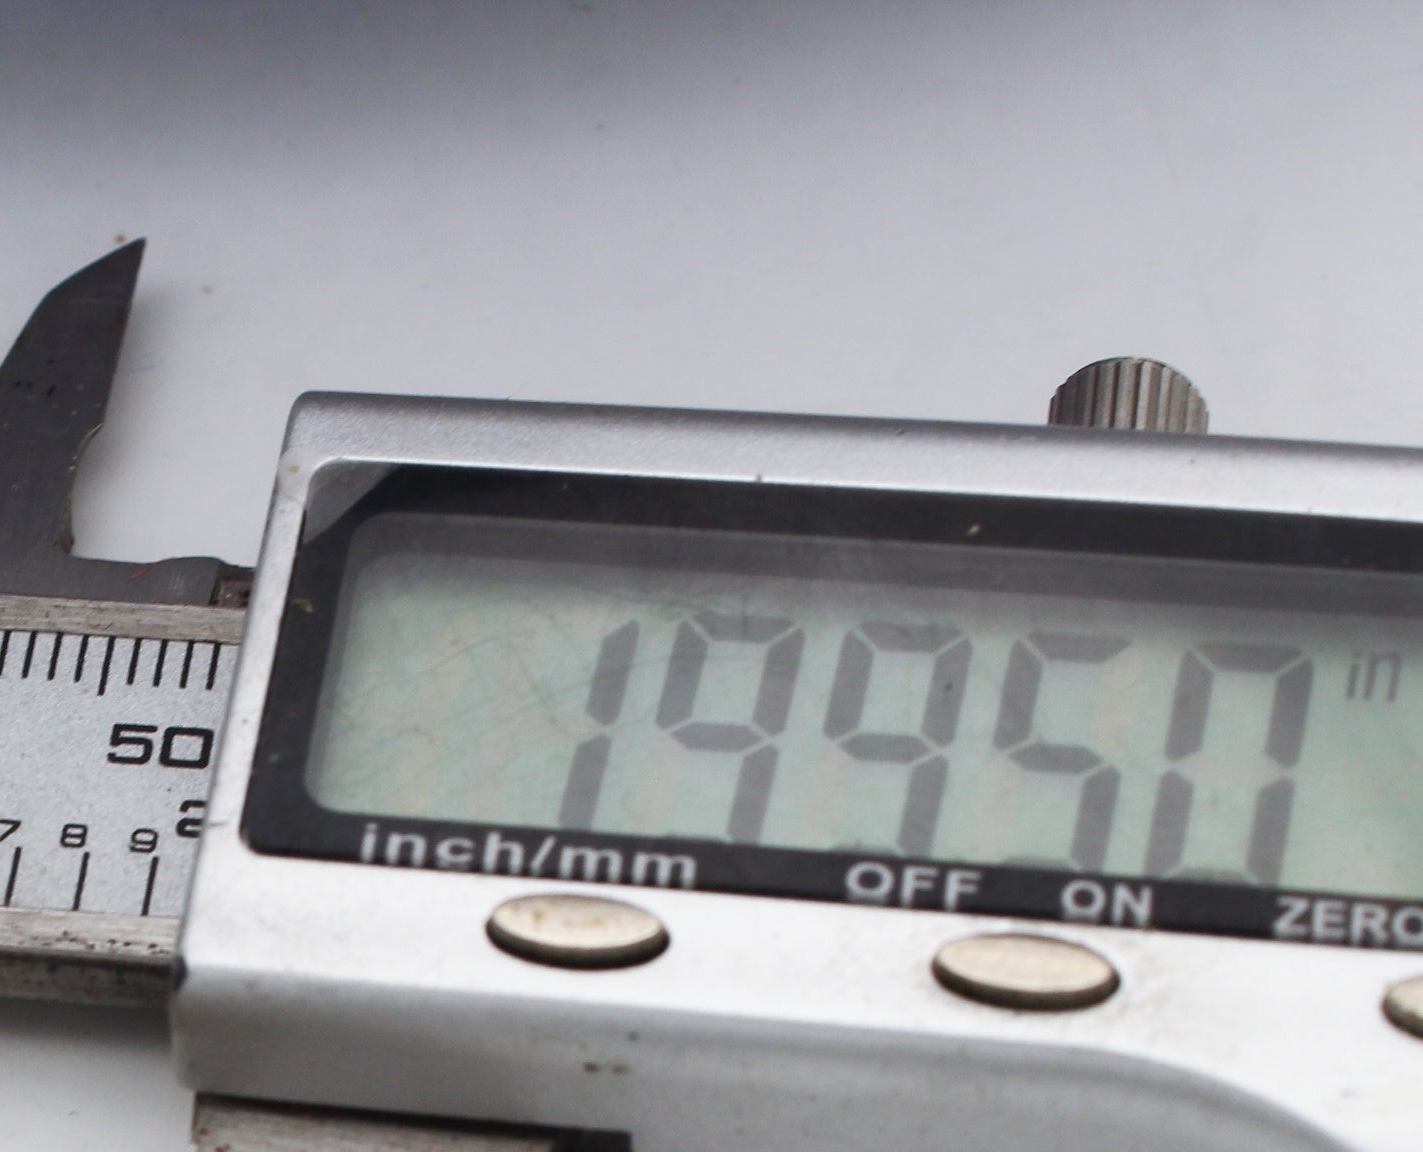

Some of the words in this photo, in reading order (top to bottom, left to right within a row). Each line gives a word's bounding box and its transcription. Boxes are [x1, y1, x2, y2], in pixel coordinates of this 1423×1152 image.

[106, 722, 216, 770] 50
[59, 823, 89, 849] 8
[129, 828, 159, 854] 9
[361, 823, 696, 889] inch/mm
[845, 861, 984, 909] OFF
[1060, 880, 1153, 926] ON
[1273, 896, 1423, 947] ZERO
